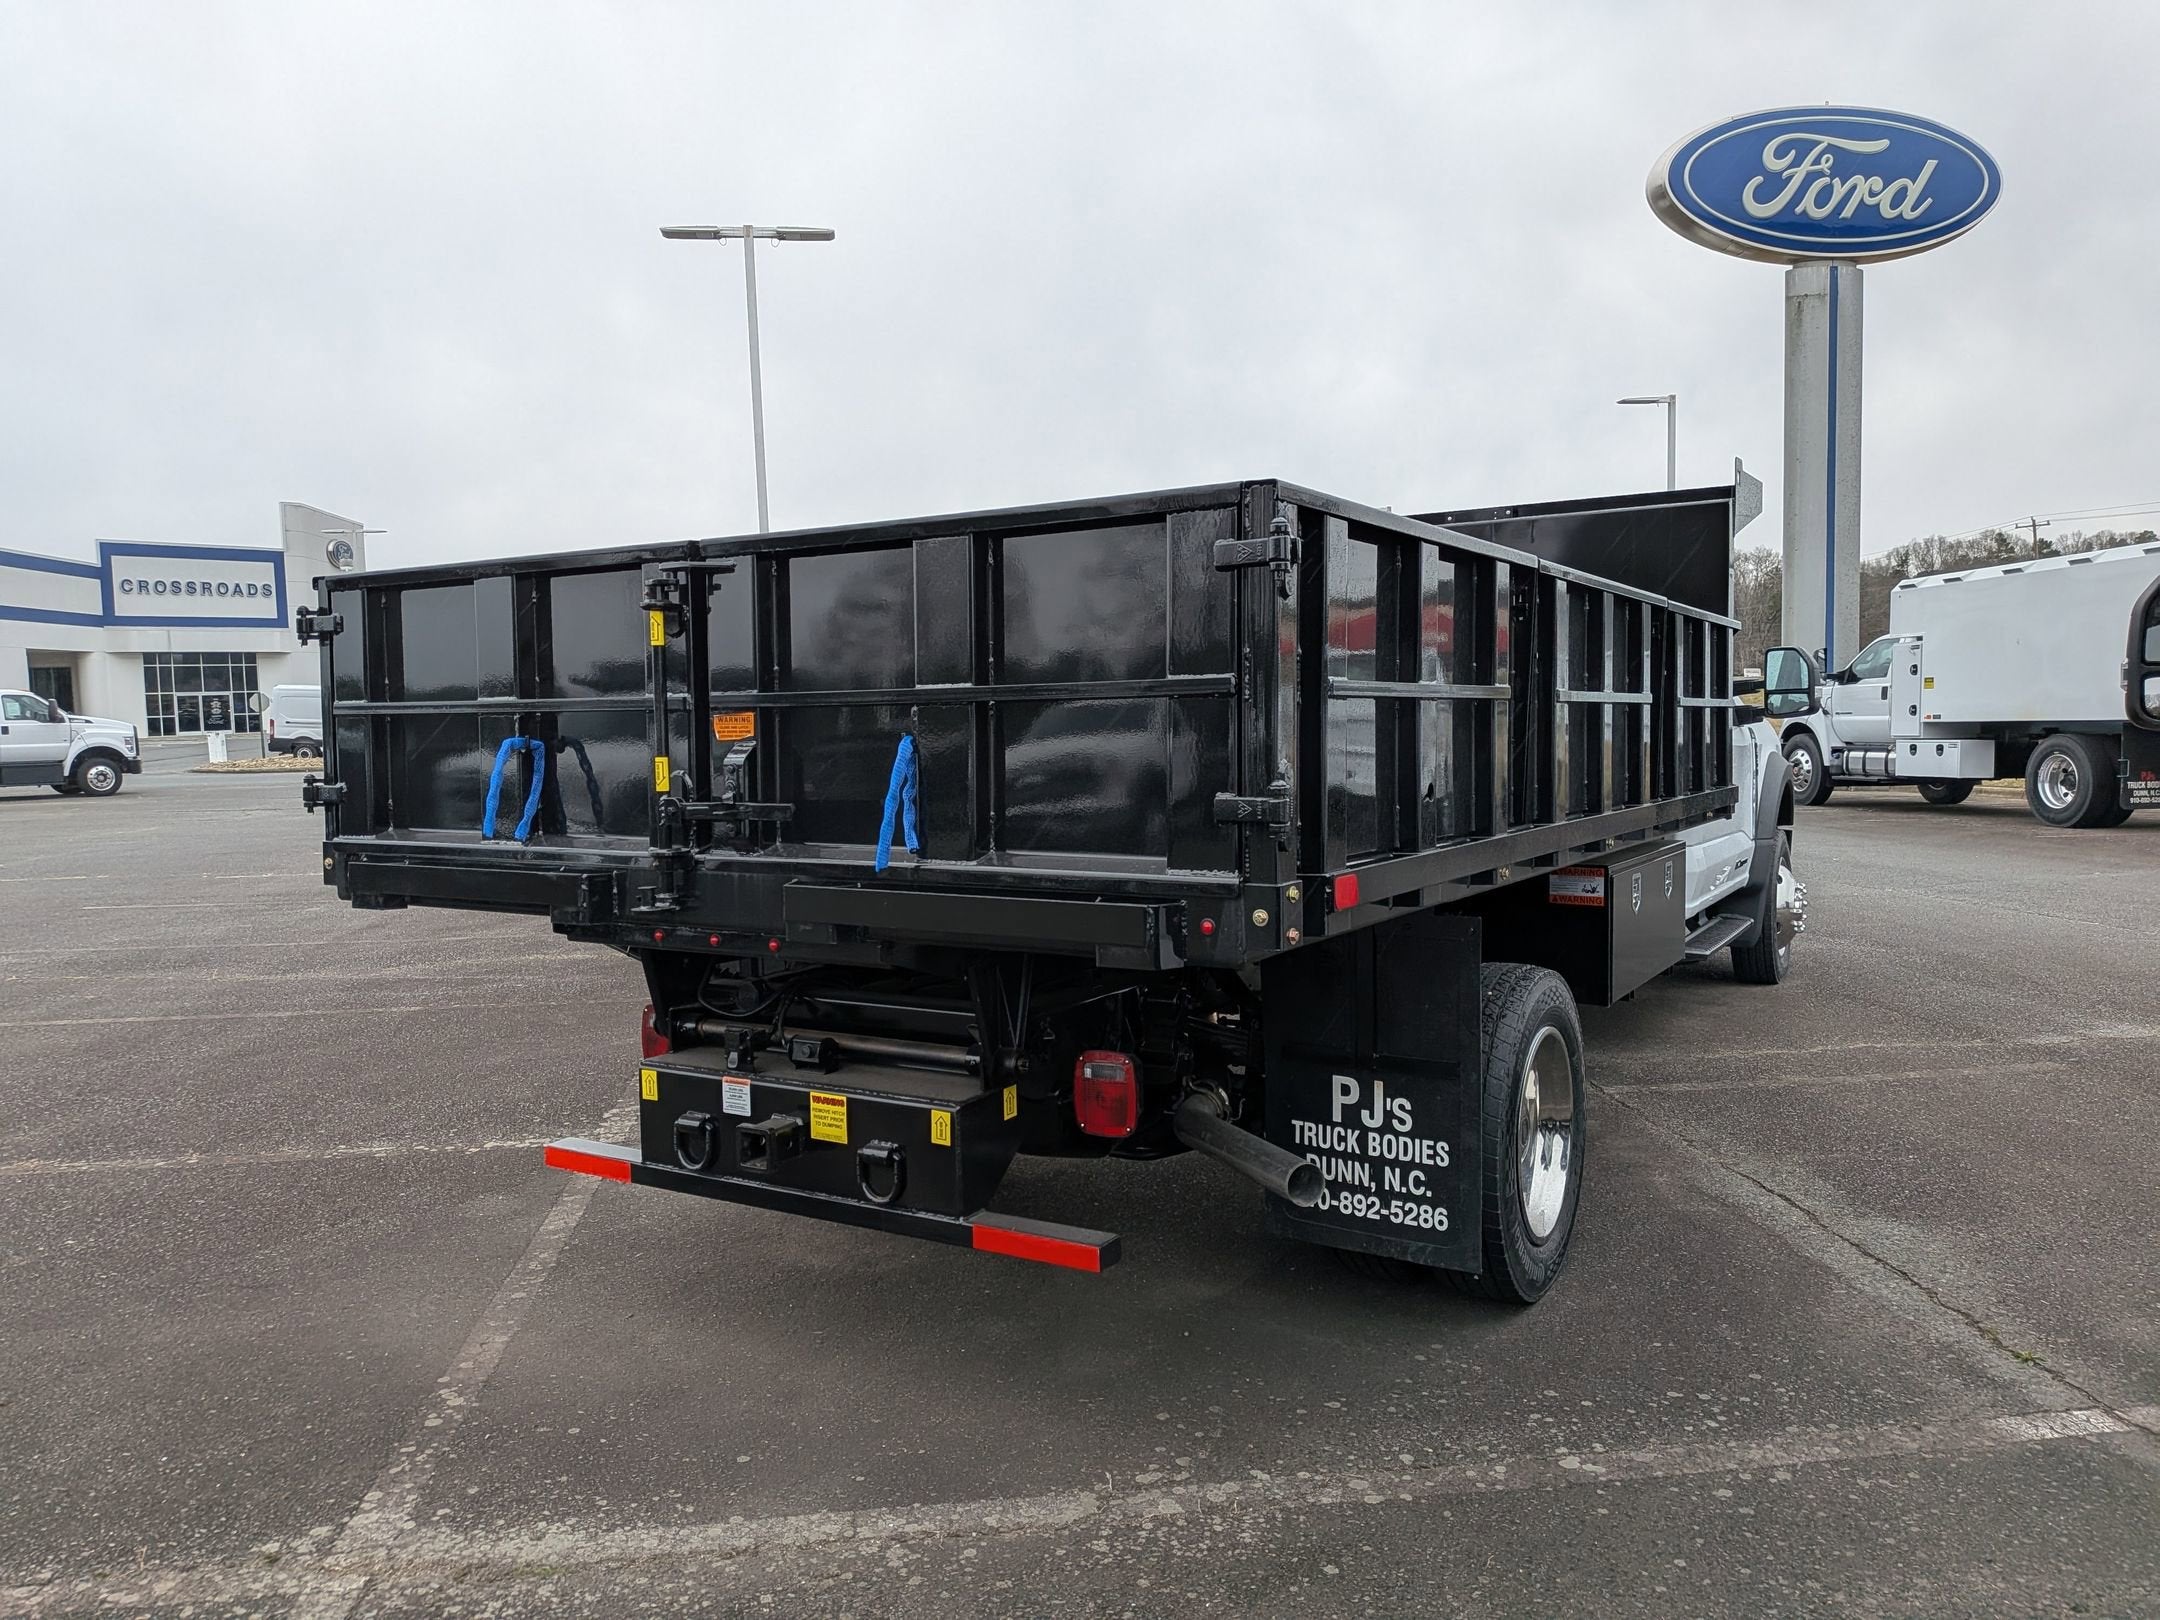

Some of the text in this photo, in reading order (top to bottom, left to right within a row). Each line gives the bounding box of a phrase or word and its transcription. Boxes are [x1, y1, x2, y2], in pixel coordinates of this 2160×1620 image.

[1742, 132, 1939, 220] Ford
[120, 578, 273, 598] CROSSROADS
[1559, 895, 1603, 905] WARNING
[1291, 1119, 1450, 1168] TRUCK BODIES
[1384, 1166, 1433, 1198] N.C.
[1310, 1188, 1449, 1232] 0-892-5286
